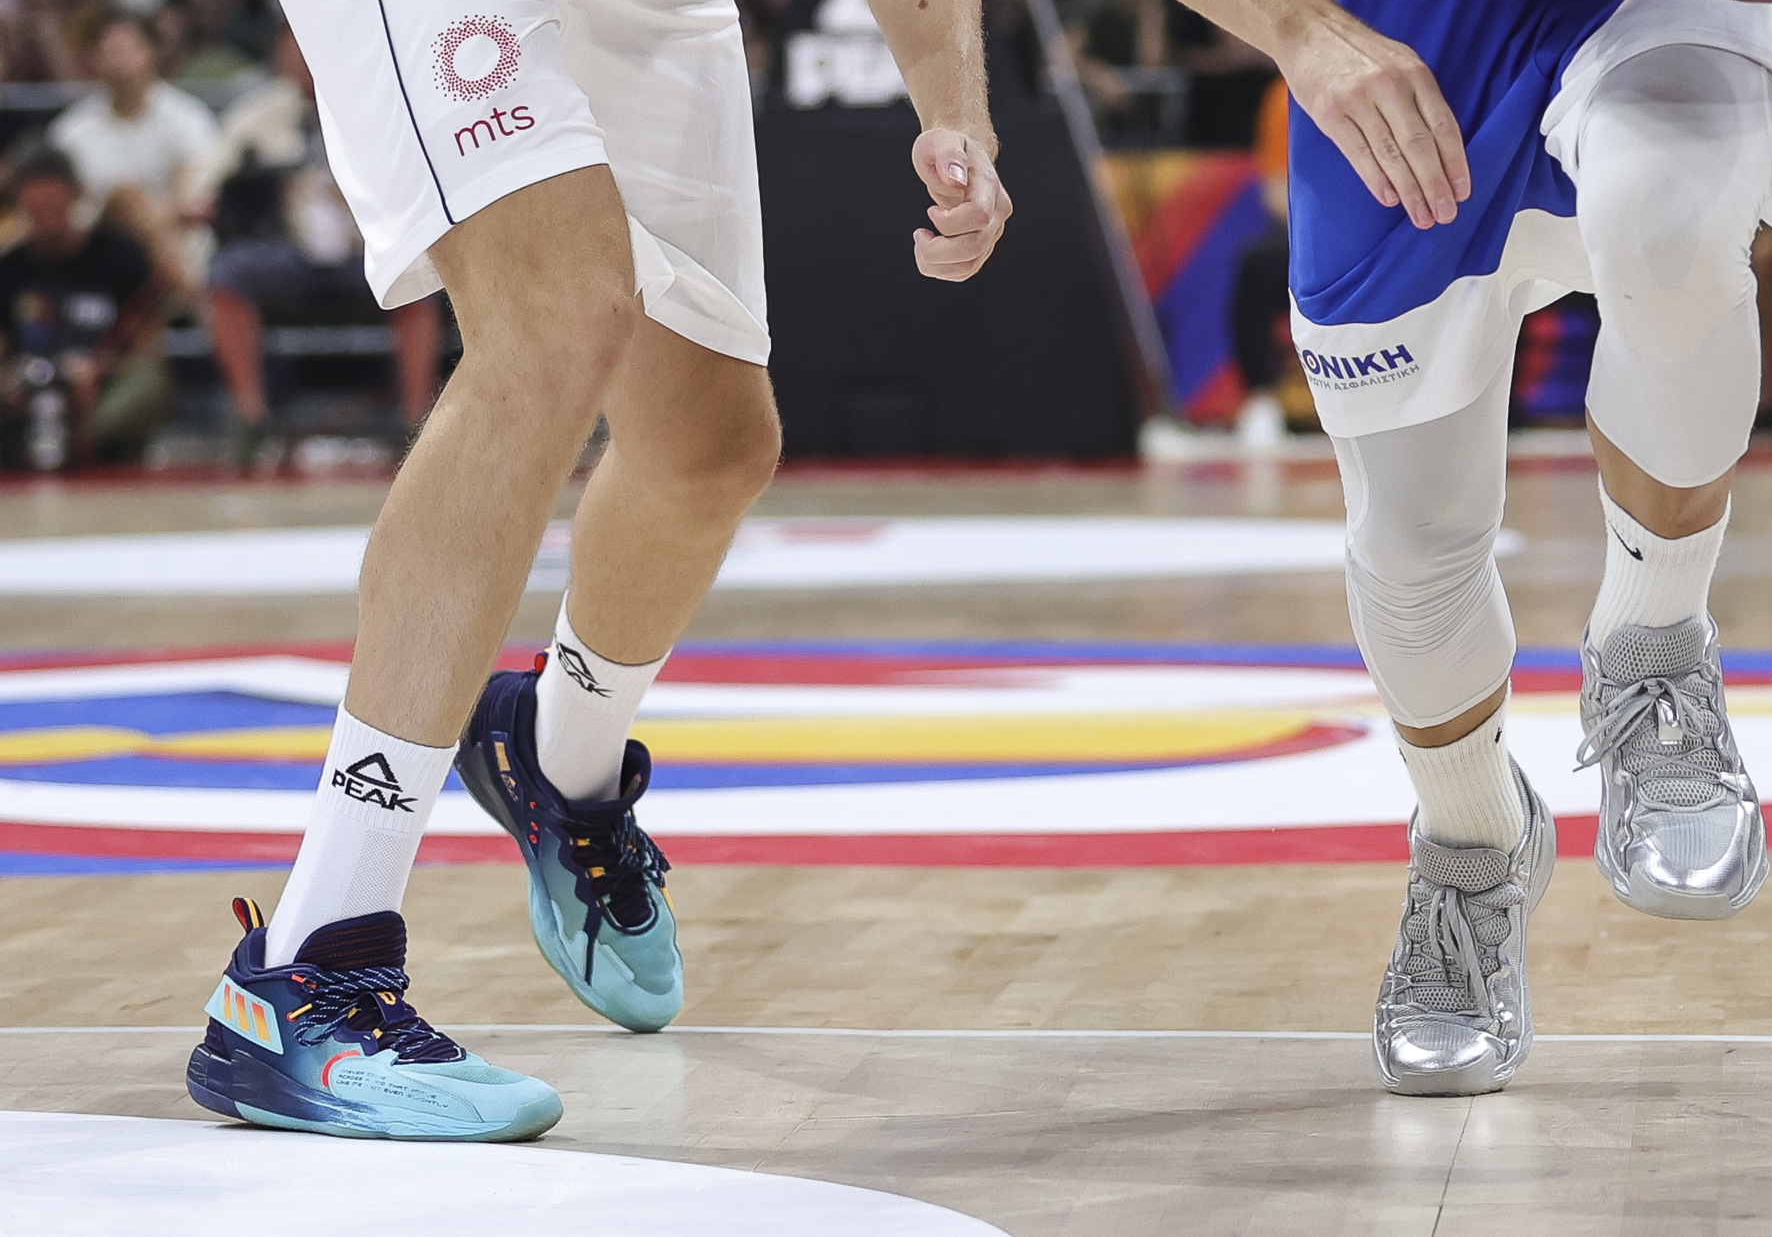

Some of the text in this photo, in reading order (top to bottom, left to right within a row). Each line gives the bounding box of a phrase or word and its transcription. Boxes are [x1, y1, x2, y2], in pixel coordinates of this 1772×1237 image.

[453, 103, 537, 157] mts
[331, 769, 420, 813] PEAK
[383, 1087, 404, 1097] EVEN
